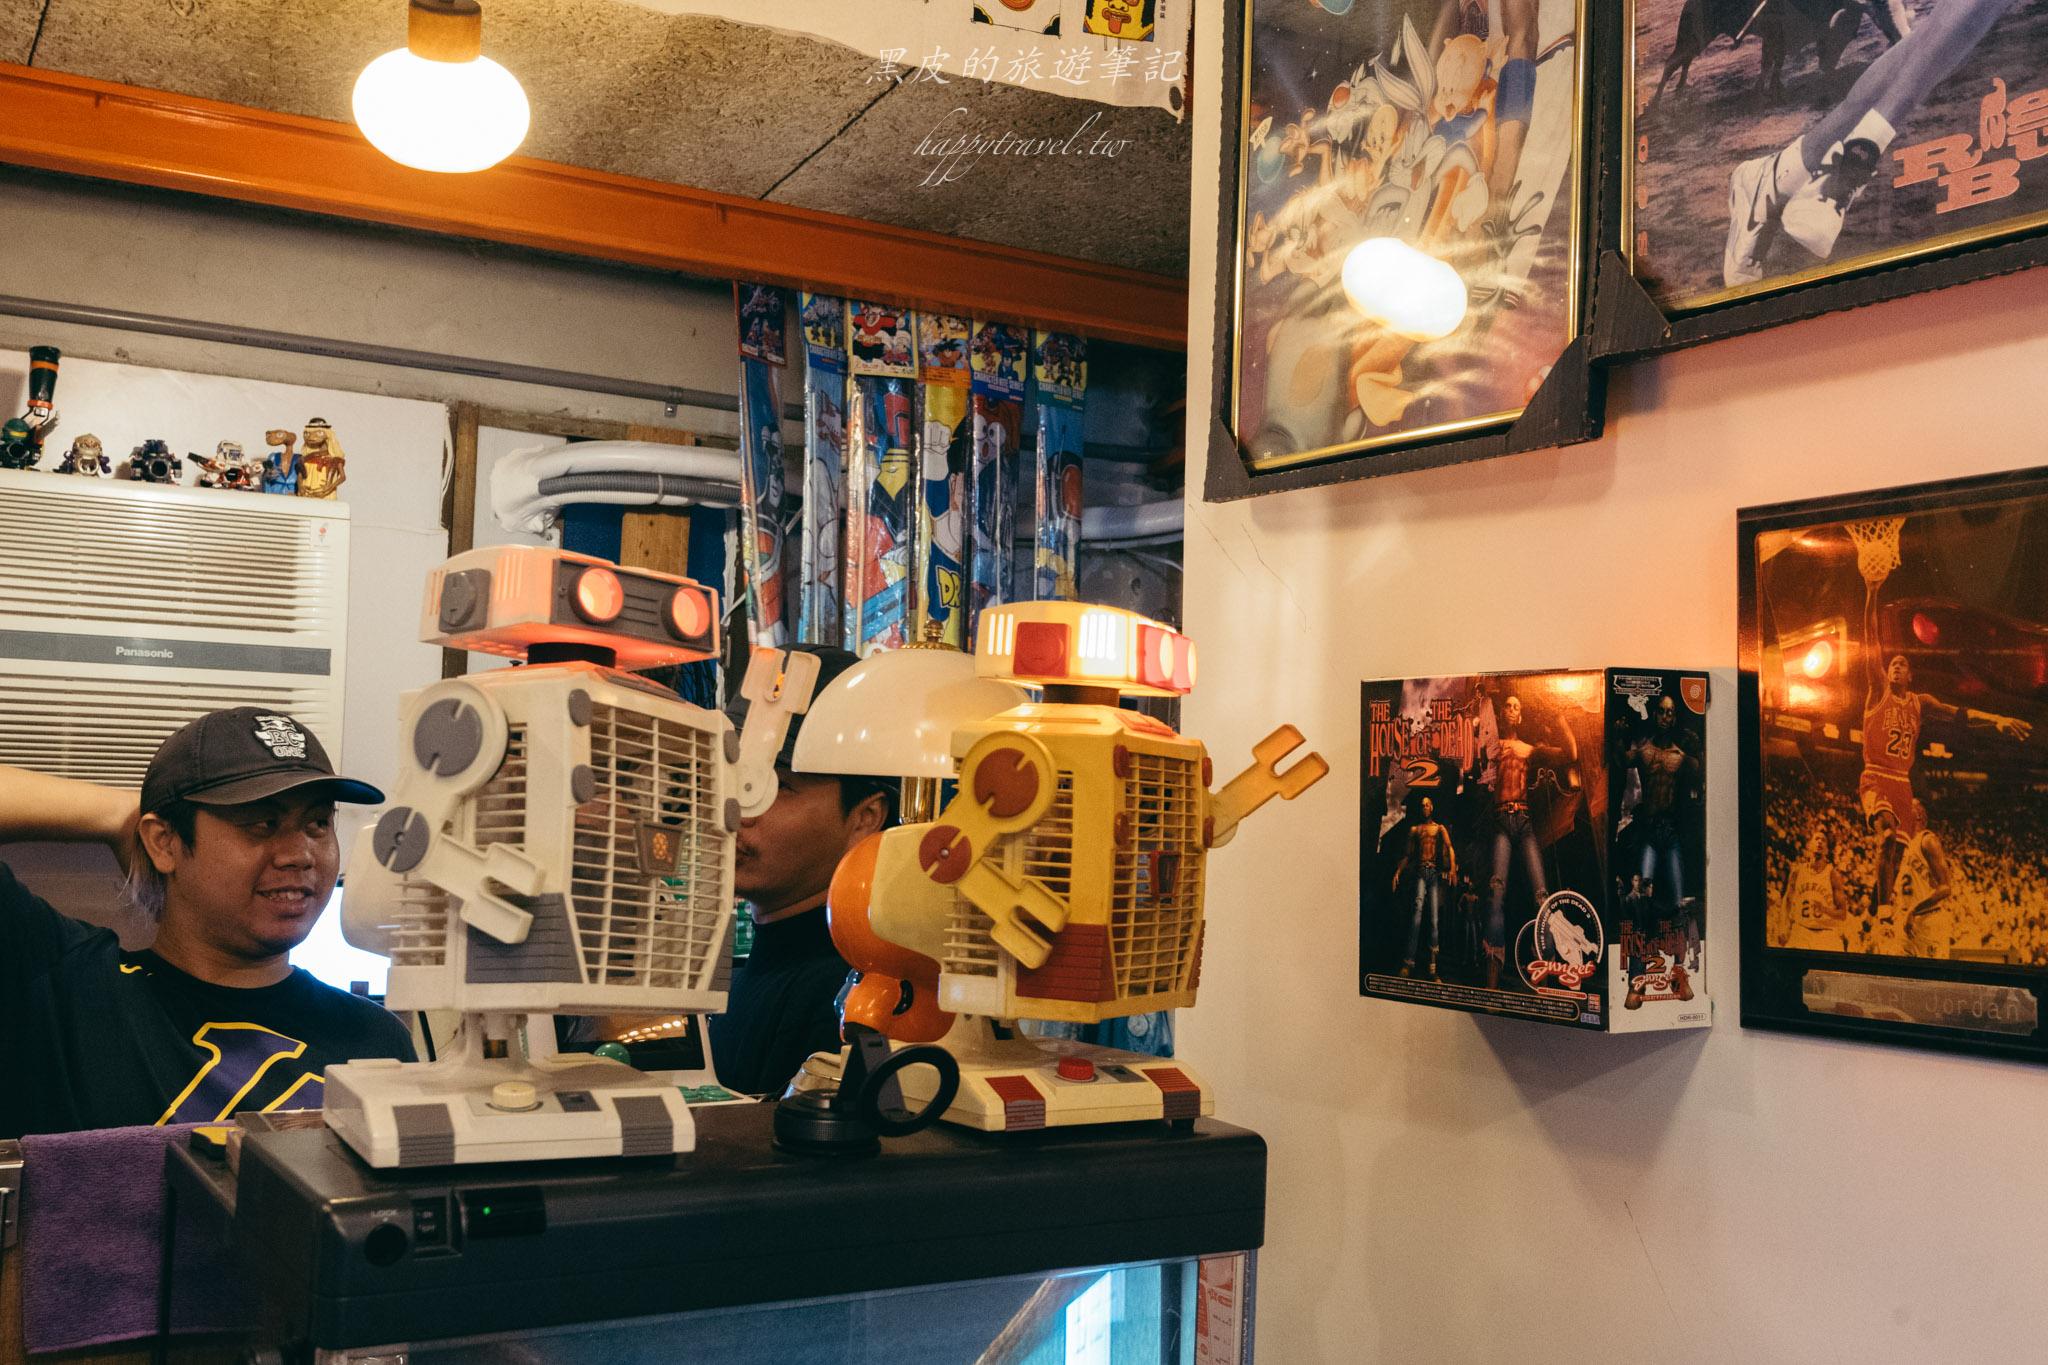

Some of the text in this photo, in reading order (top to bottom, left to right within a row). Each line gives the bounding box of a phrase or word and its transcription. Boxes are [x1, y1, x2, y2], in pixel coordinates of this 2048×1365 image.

[116, 646, 173, 658] Panasonic
[1370, 701, 1473, 777] THE HOUSE OF THE DEAD
[1886, 729, 1911, 759] 23
[1406, 758, 1440, 787] 2
[1645, 956, 1666, 973] 2
